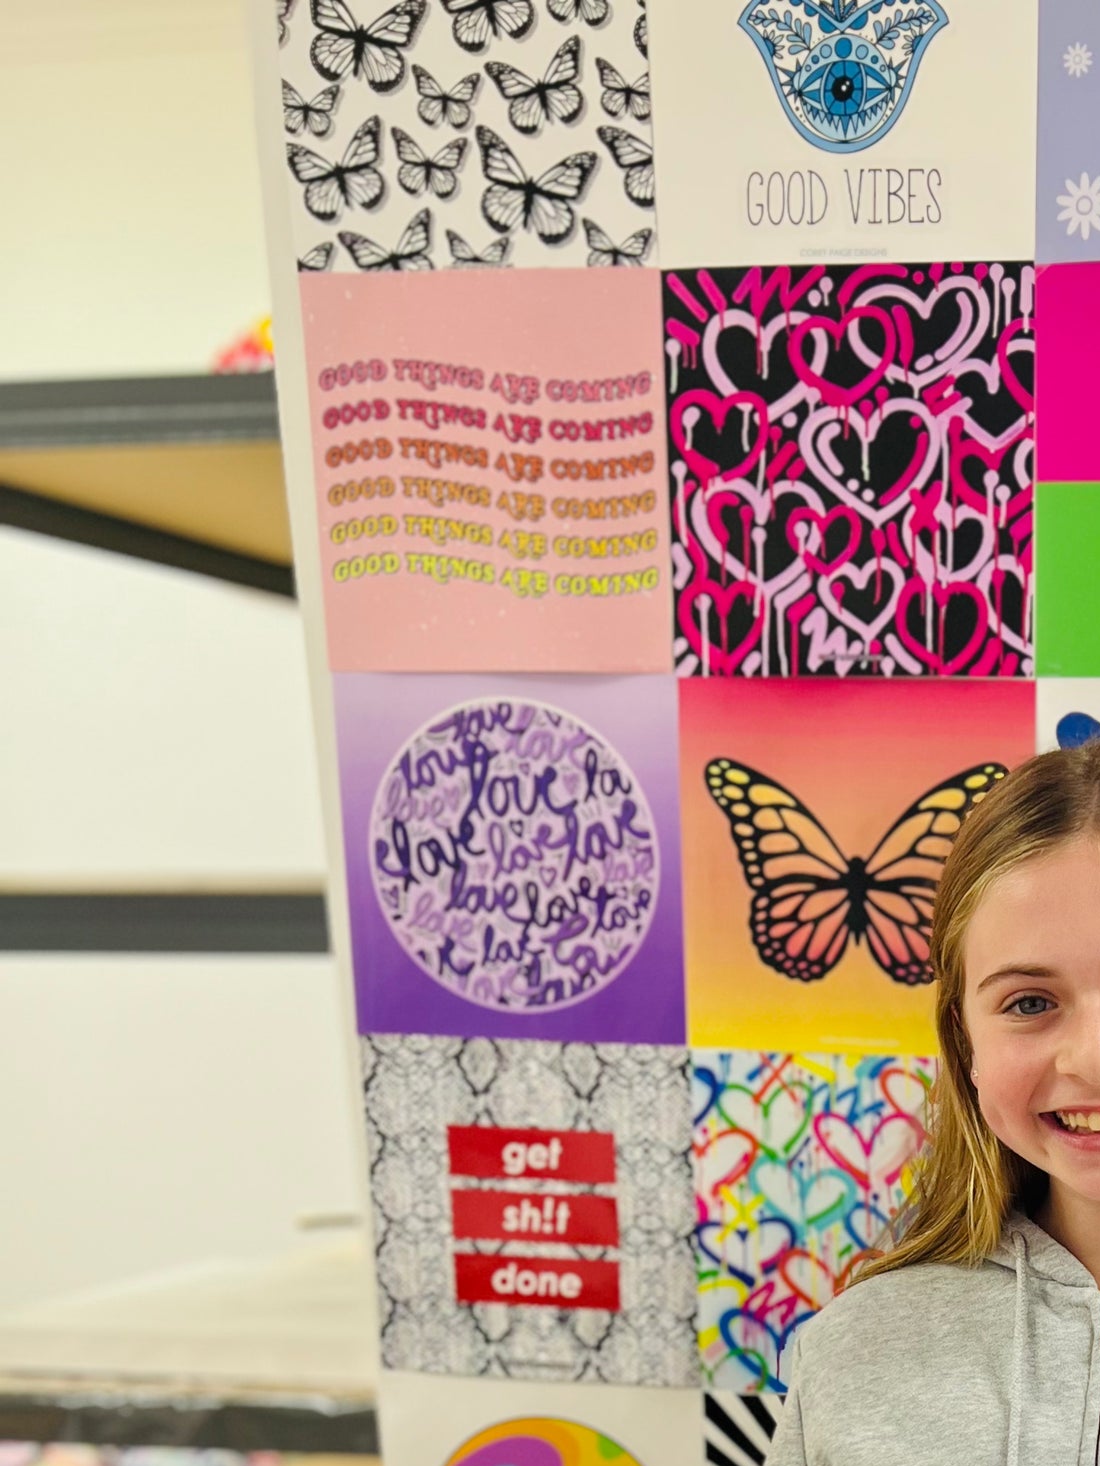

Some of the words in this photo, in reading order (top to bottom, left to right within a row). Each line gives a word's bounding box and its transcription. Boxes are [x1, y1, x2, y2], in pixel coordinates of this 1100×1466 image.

[746, 170, 828, 226] GOOD
[844, 168, 942, 225] VIBES
[319, 359, 388, 391] GOOD
[392, 359, 484, 391] THINGS
[490, 373, 539, 404] ARE
[546, 370, 652, 403] COMING
[323, 399, 390, 429] GOOD
[396, 399, 487, 429] THINGS
[493, 413, 542, 443] ARE
[549, 411, 654, 442] COMING
[325, 437, 393, 469] GOOD
[398, 437, 489, 469] THINGS
[495, 451, 544, 483] ARE
[551, 450, 655, 481] COMING
[328, 476, 395, 506] GOOD
[400, 476, 491, 507] THINGS
[497, 491, 546, 522] ARE
[552, 490, 656, 520] COMING
[330, 514, 398, 545] GOOD
[402, 514, 493, 546] THINGS
[499, 529, 547, 560] ARE
[554, 528, 657, 558] COMING
[333, 552, 400, 583] GOOD
[404, 552, 495, 584] THINGS
[501, 567, 549, 597] ARE
[555, 566, 659, 596] COMING
[468, 740, 578, 820] love
[393, 817, 486, 892] love
[488, 821, 568, 881] love
[562, 799, 650, 882] love
[502, 1137, 563, 1176] get
[502, 1196, 570, 1235] sh!t
[491, 1262, 582, 1299] done
